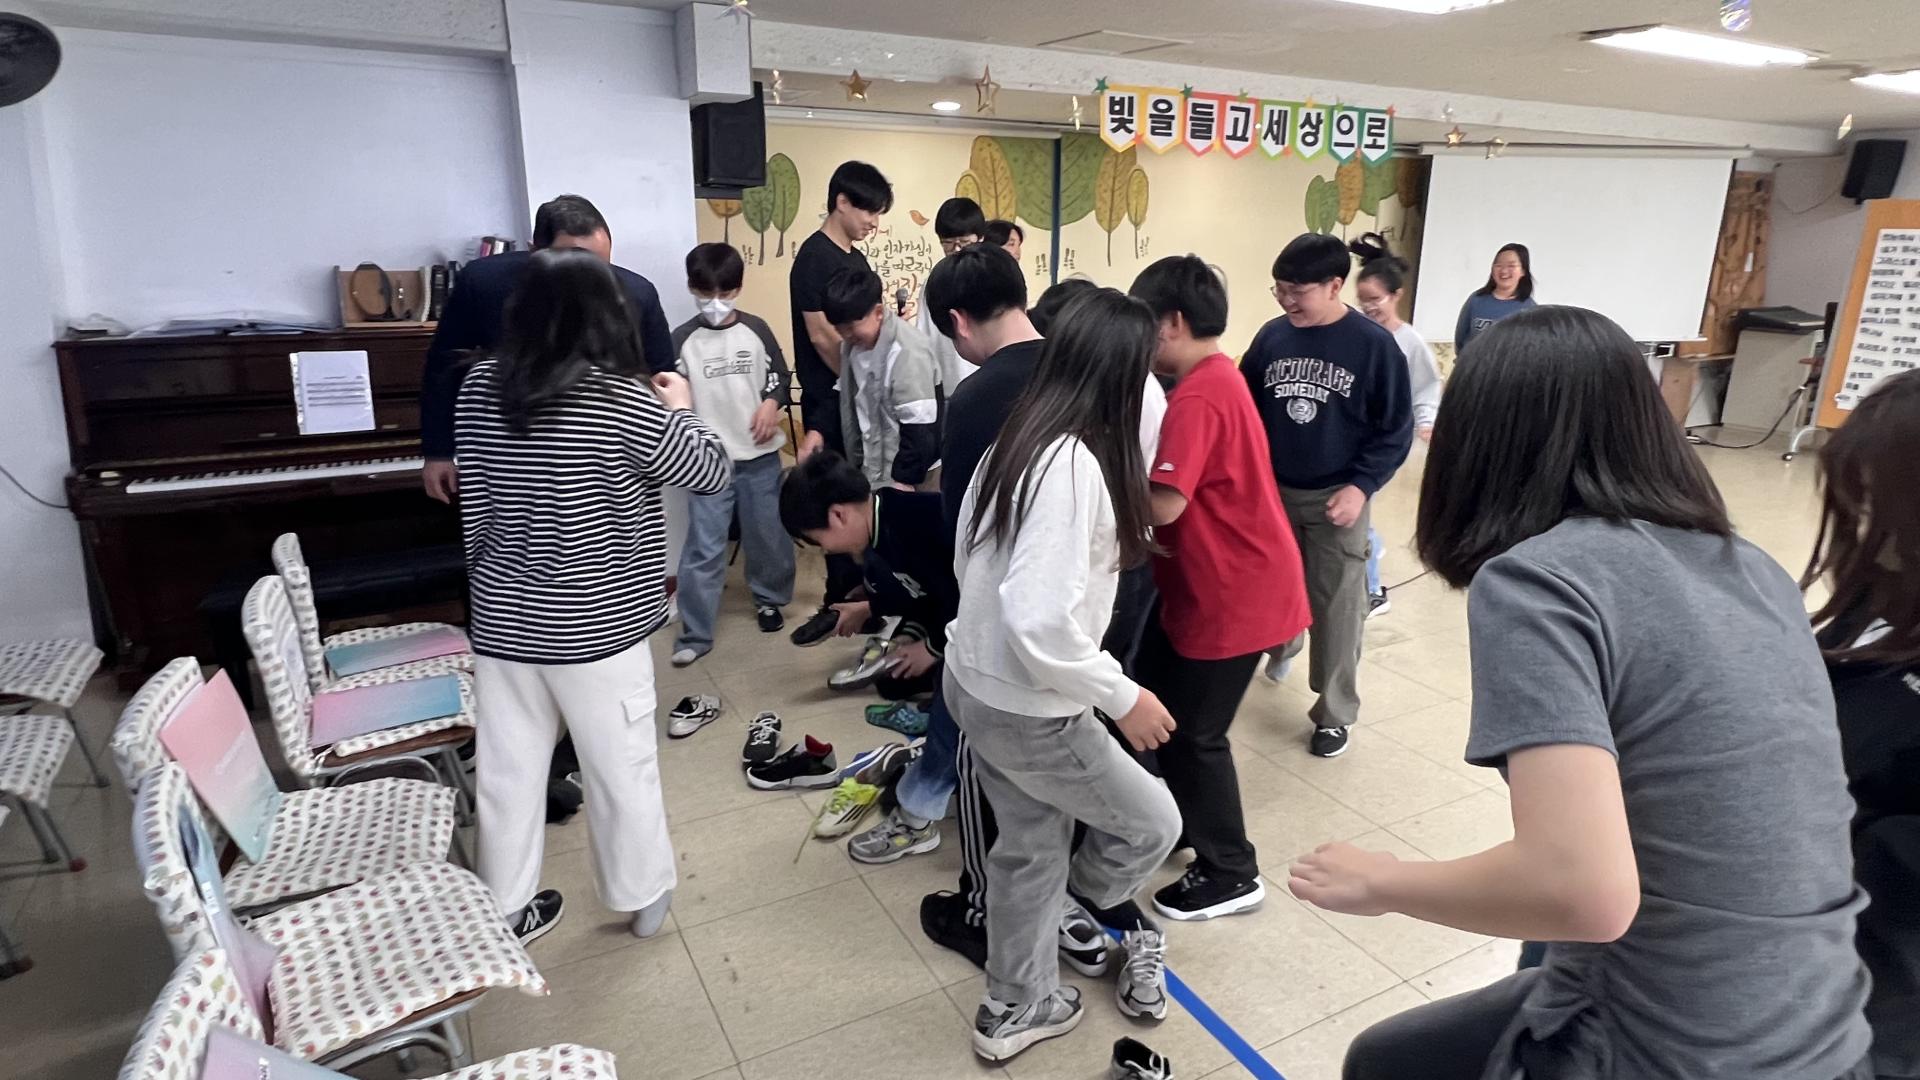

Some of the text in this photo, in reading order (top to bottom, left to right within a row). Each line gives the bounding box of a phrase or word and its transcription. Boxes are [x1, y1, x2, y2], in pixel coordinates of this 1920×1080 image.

[1108, 95, 1176, 138] 빛을
[1189, 101, 1251, 143] 들고
[1274, 382, 1330, 404] SOMEDAY
